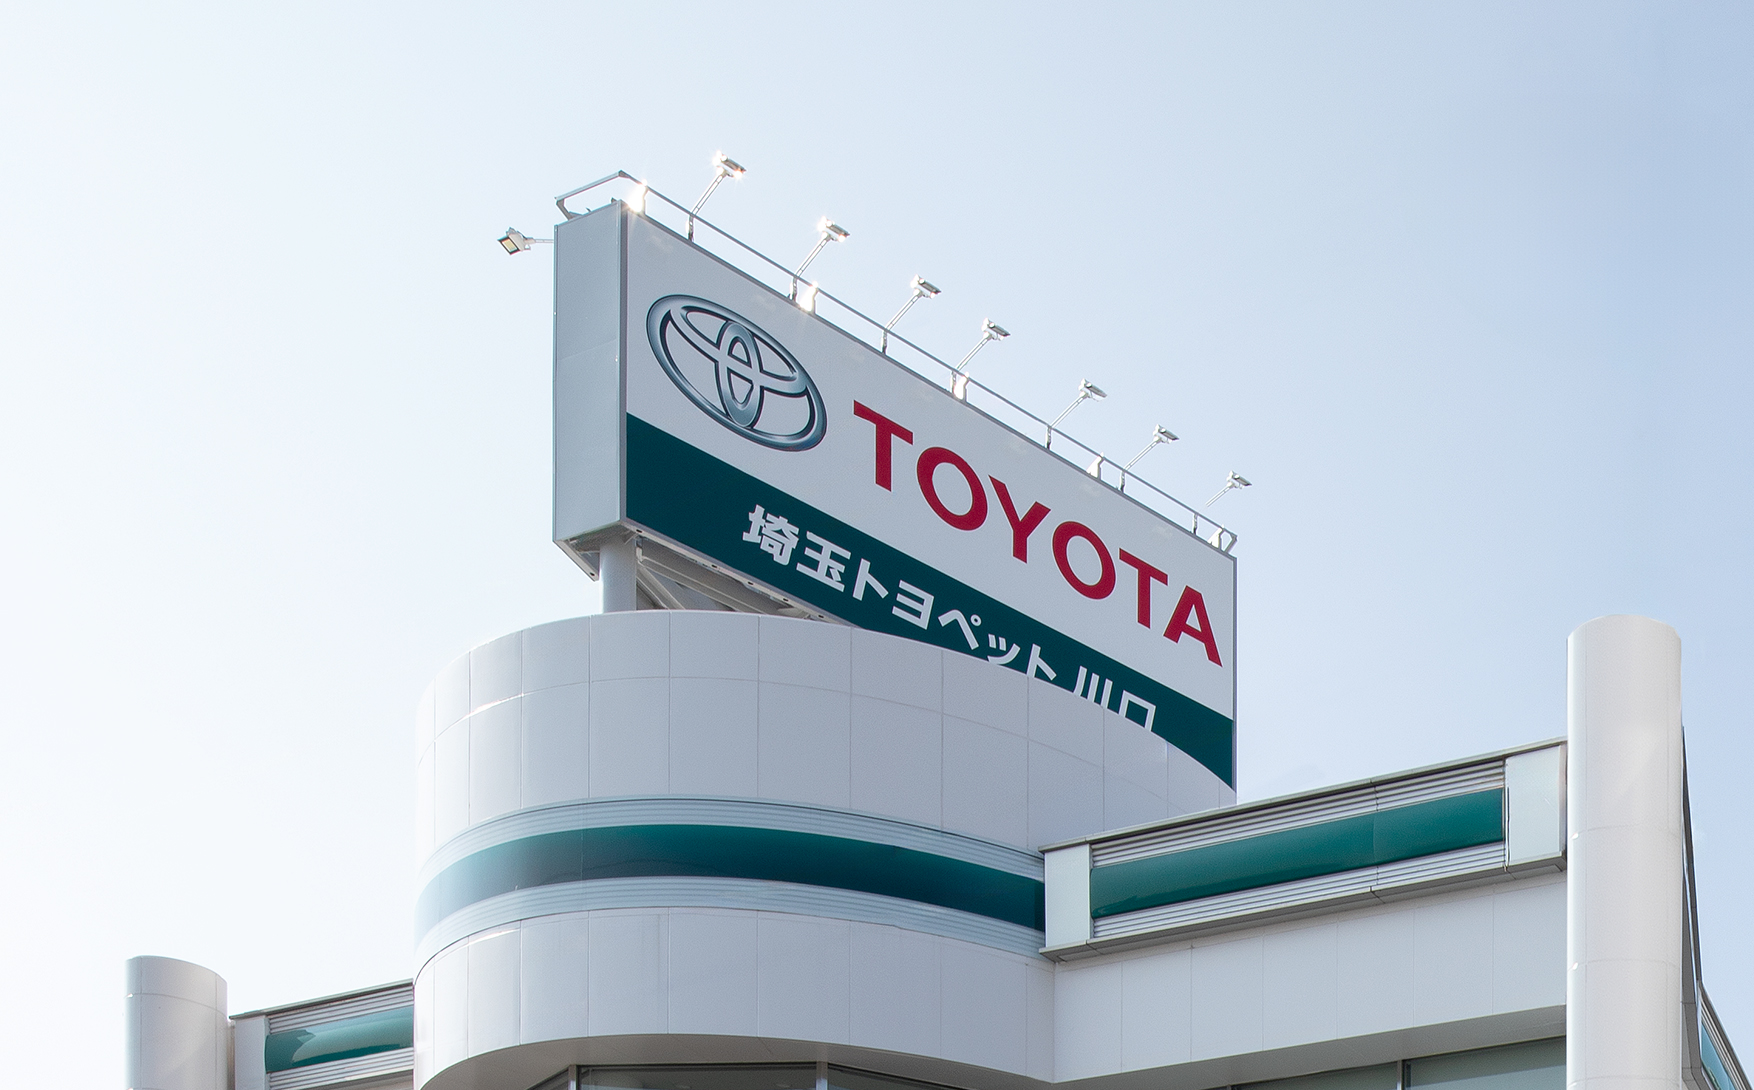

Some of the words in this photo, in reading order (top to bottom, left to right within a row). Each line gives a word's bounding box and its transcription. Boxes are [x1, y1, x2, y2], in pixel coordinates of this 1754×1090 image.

[742, 504, 1057, 681] 埼玉トヨペット
[1073, 665, 1157, 731] 川口
[853, 399, 1222, 667] TOYOTA
